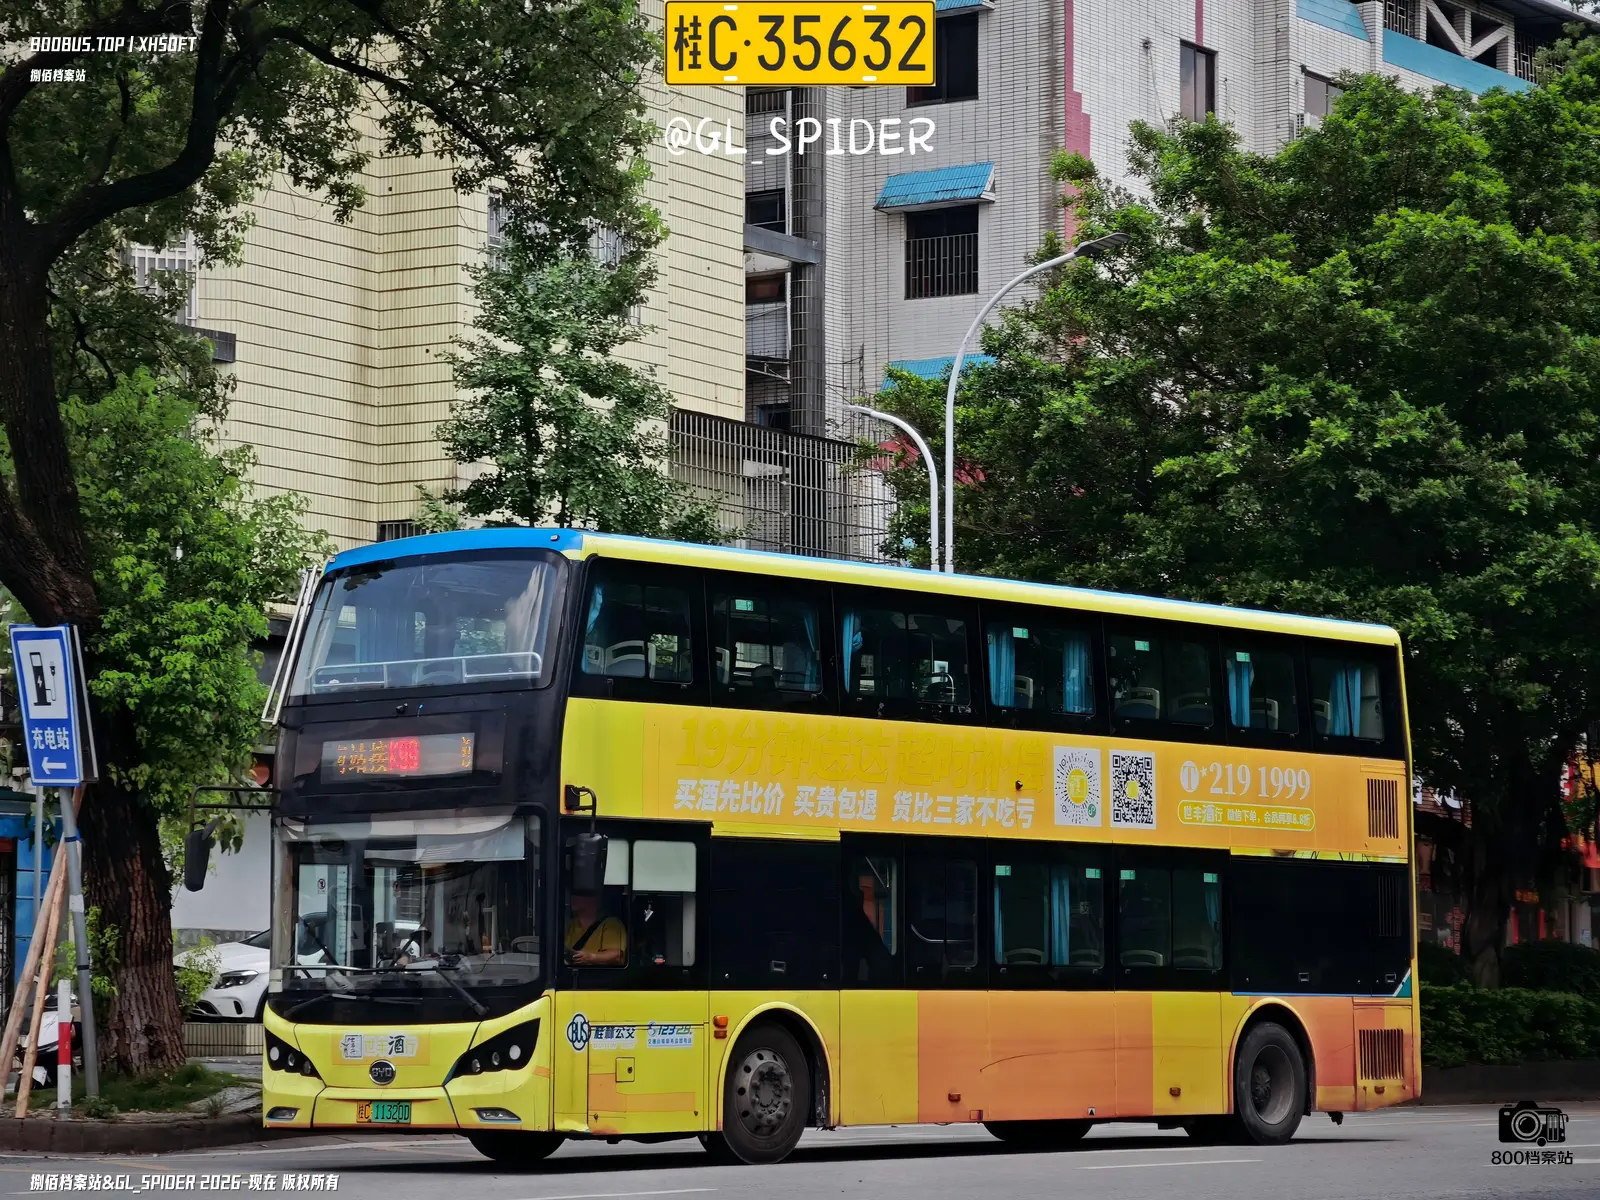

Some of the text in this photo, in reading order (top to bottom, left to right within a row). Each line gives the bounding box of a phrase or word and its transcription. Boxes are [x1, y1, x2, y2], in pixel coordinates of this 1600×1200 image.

[31, 726, 70, 750] 充电站
[675, 716, 1048, 793] 19分钟送达 超时补偿
[1257, 766, 1311, 801] 1999
[674, 778, 1035, 829] 买酒先比价 买贵包退 货比三家不吃亏
[372, 1067, 393, 1078] BYD
